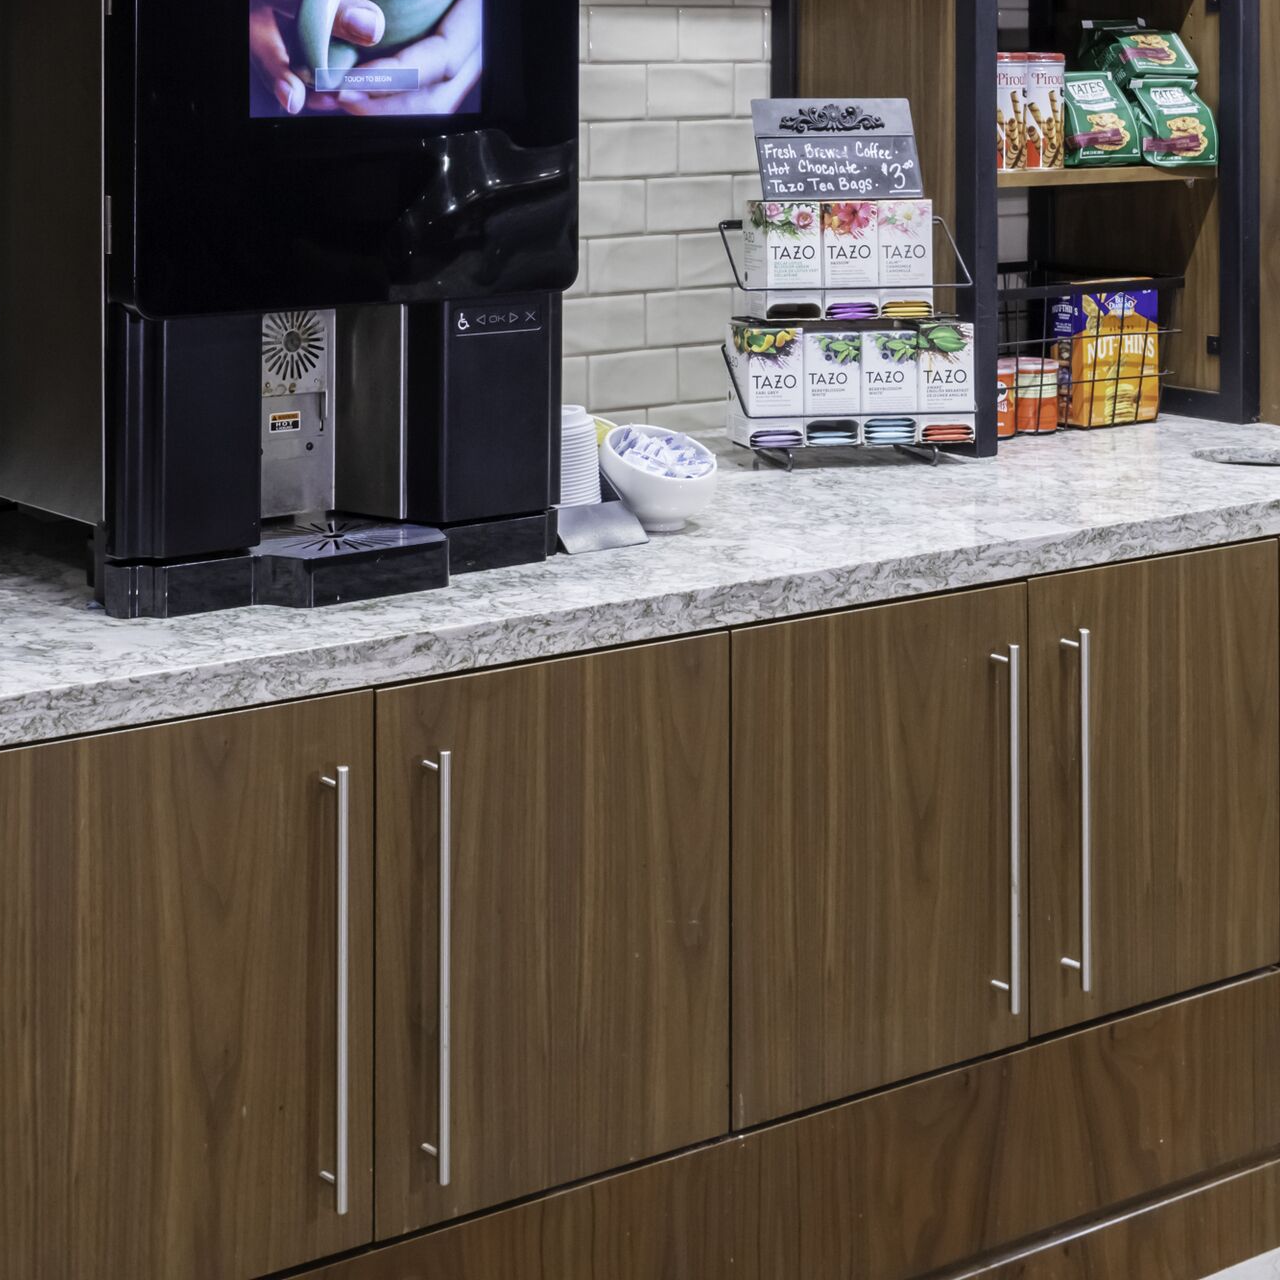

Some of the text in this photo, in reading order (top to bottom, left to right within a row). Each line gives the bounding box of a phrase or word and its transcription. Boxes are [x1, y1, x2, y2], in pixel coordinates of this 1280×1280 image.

[344, 75, 392, 83] TOUCH TO BEGIN
[1069, 81, 1105, 95] TATE'S
[1152, 89, 1186, 100] TATE'S
[764, 144, 797, 160] Fresh
[855, 141, 893, 159] Coffee
[768, 160, 860, 176] Hot Chocolate
[770, 177, 873, 194] Tazo Tea Bags
[770, 245, 816, 260] TAZO
[827, 245, 871, 259] TAZO
[882, 244, 926, 259] TAZO
[489, 314, 506, 324] OK
[1087, 333, 1155, 363] NUT-THINS
[752, 374, 797, 389] TAZO
[808, 372, 848, 385] TAZO
[866, 371, 905, 383] TAZO
[923, 369, 968, 384] TAZO
